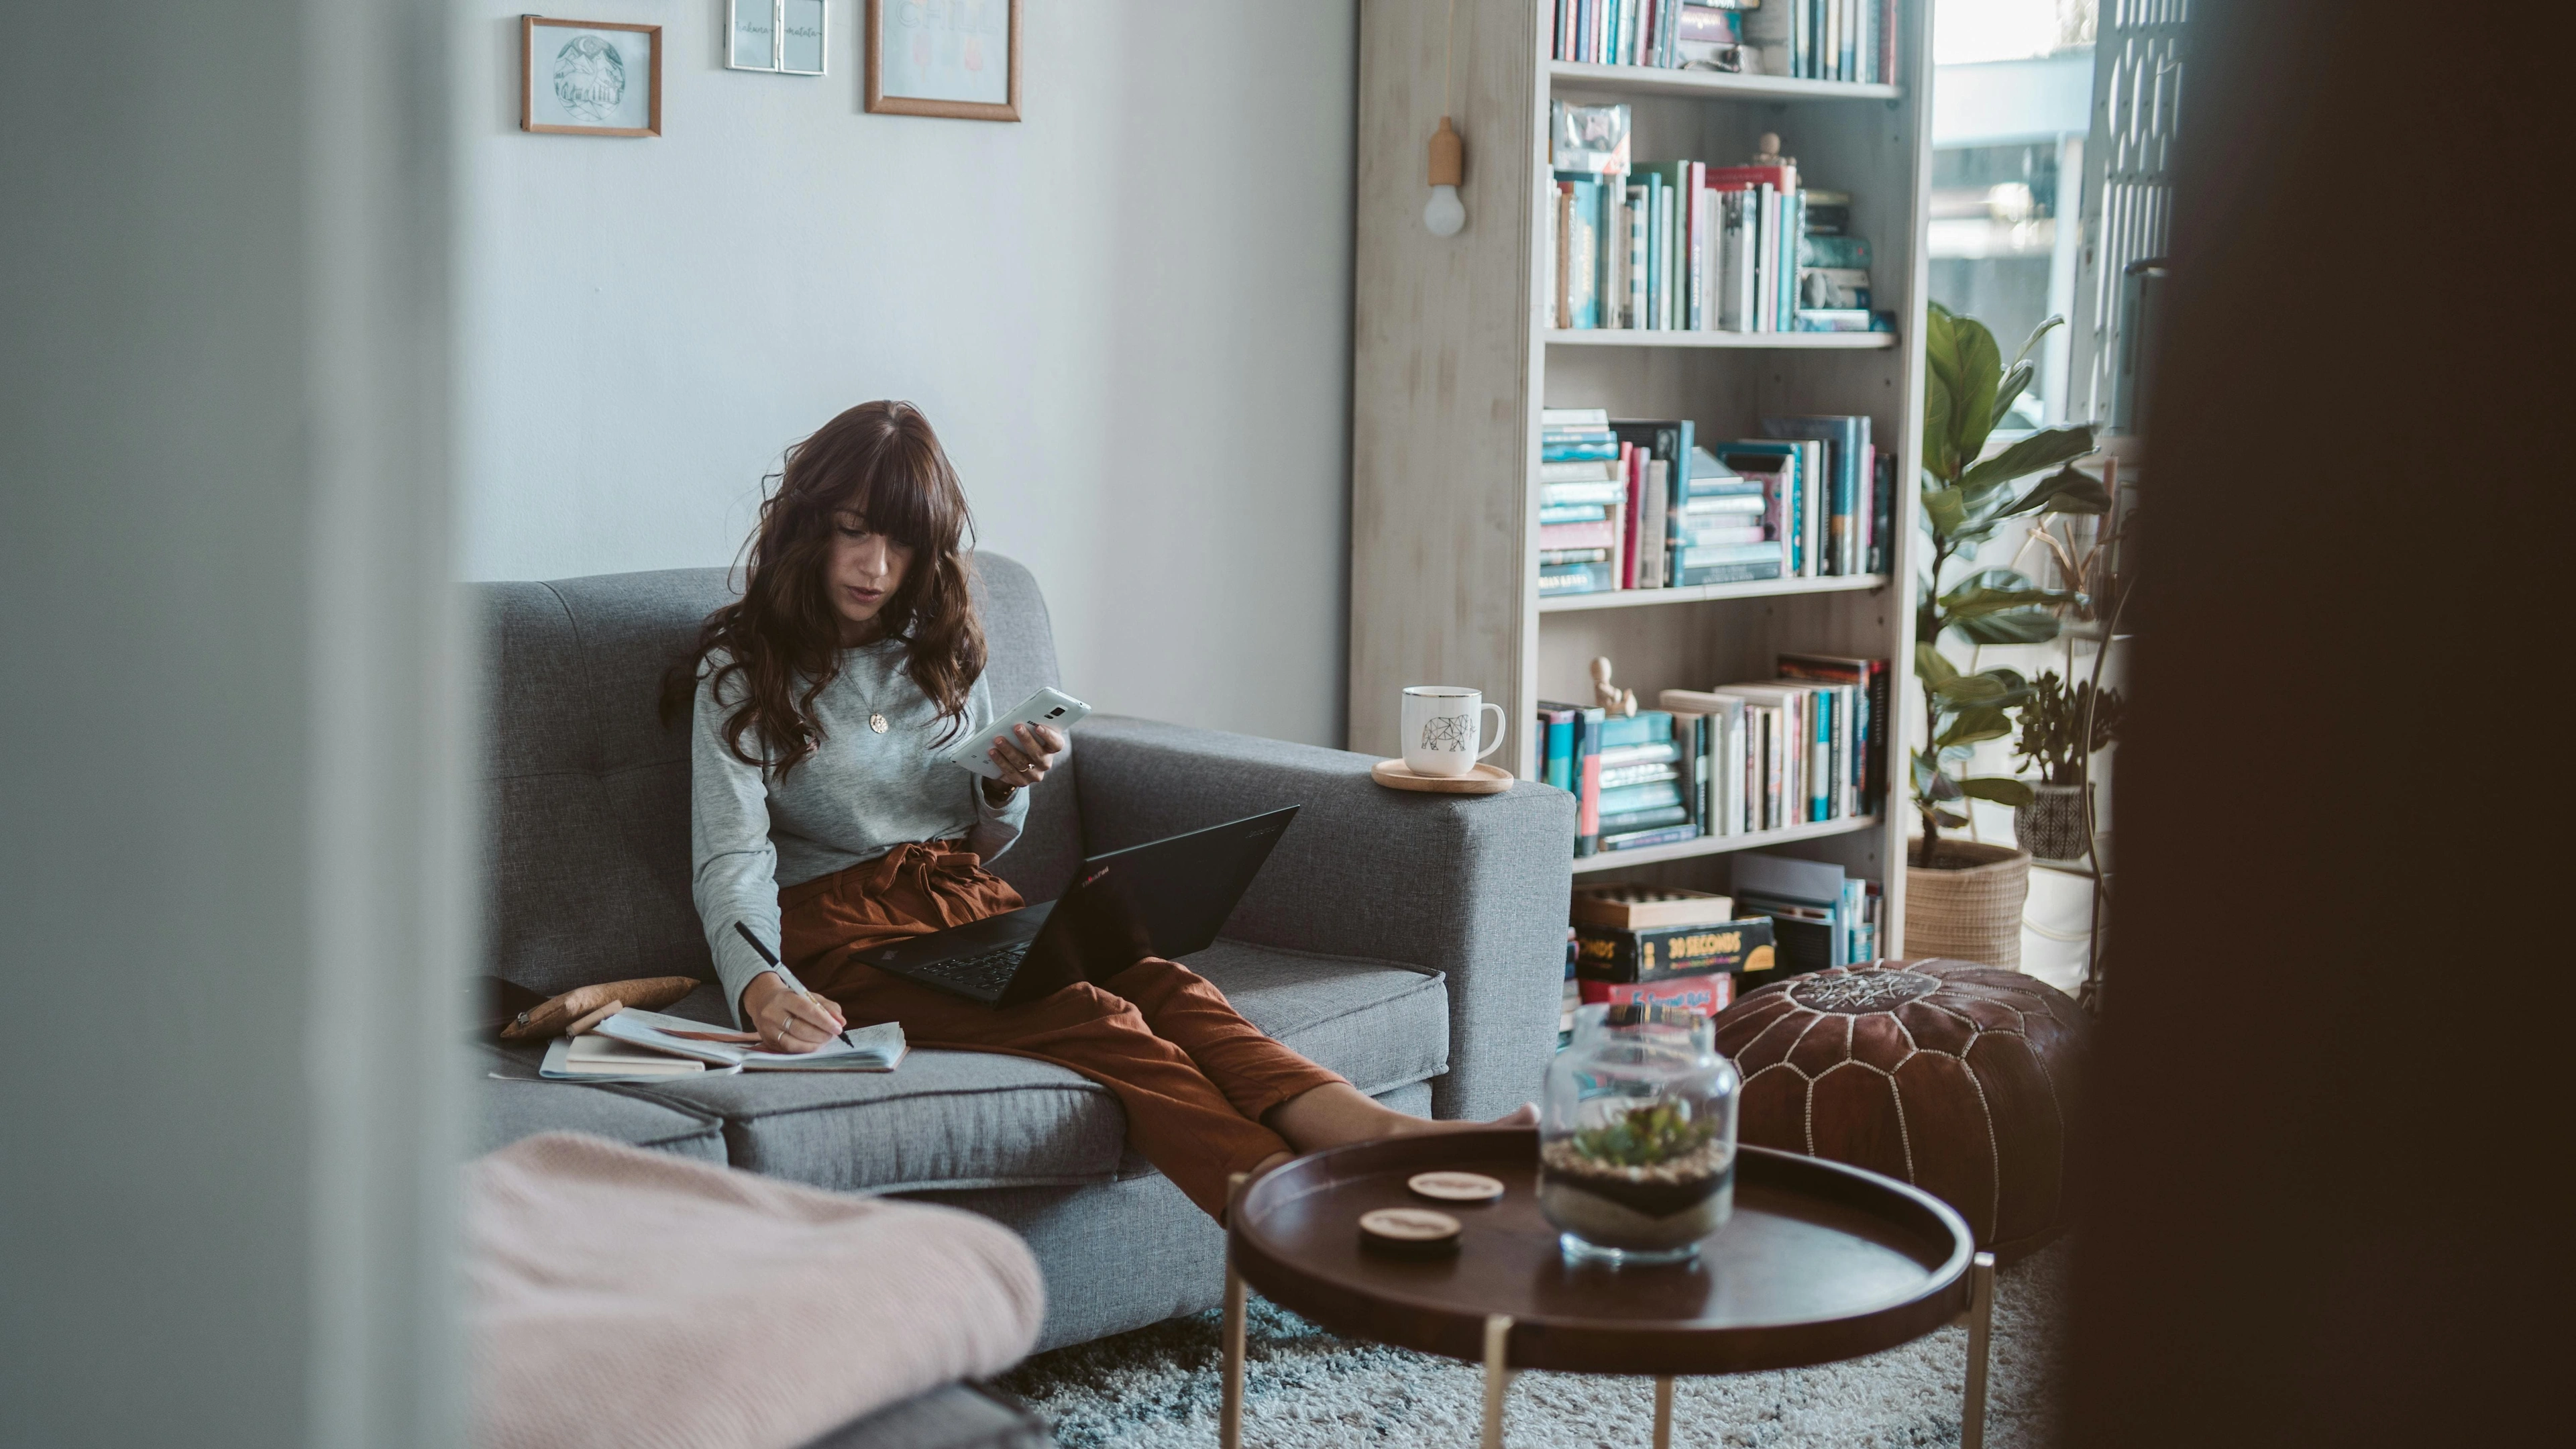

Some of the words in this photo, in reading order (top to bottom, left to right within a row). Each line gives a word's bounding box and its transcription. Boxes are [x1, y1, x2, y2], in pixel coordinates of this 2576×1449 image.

[785, 26, 818, 38] matata
[1082, 865, 1109, 888] ThinkPad
[1668, 936, 1686, 959] 30
[1685, 930, 1742, 958] SECONDS
